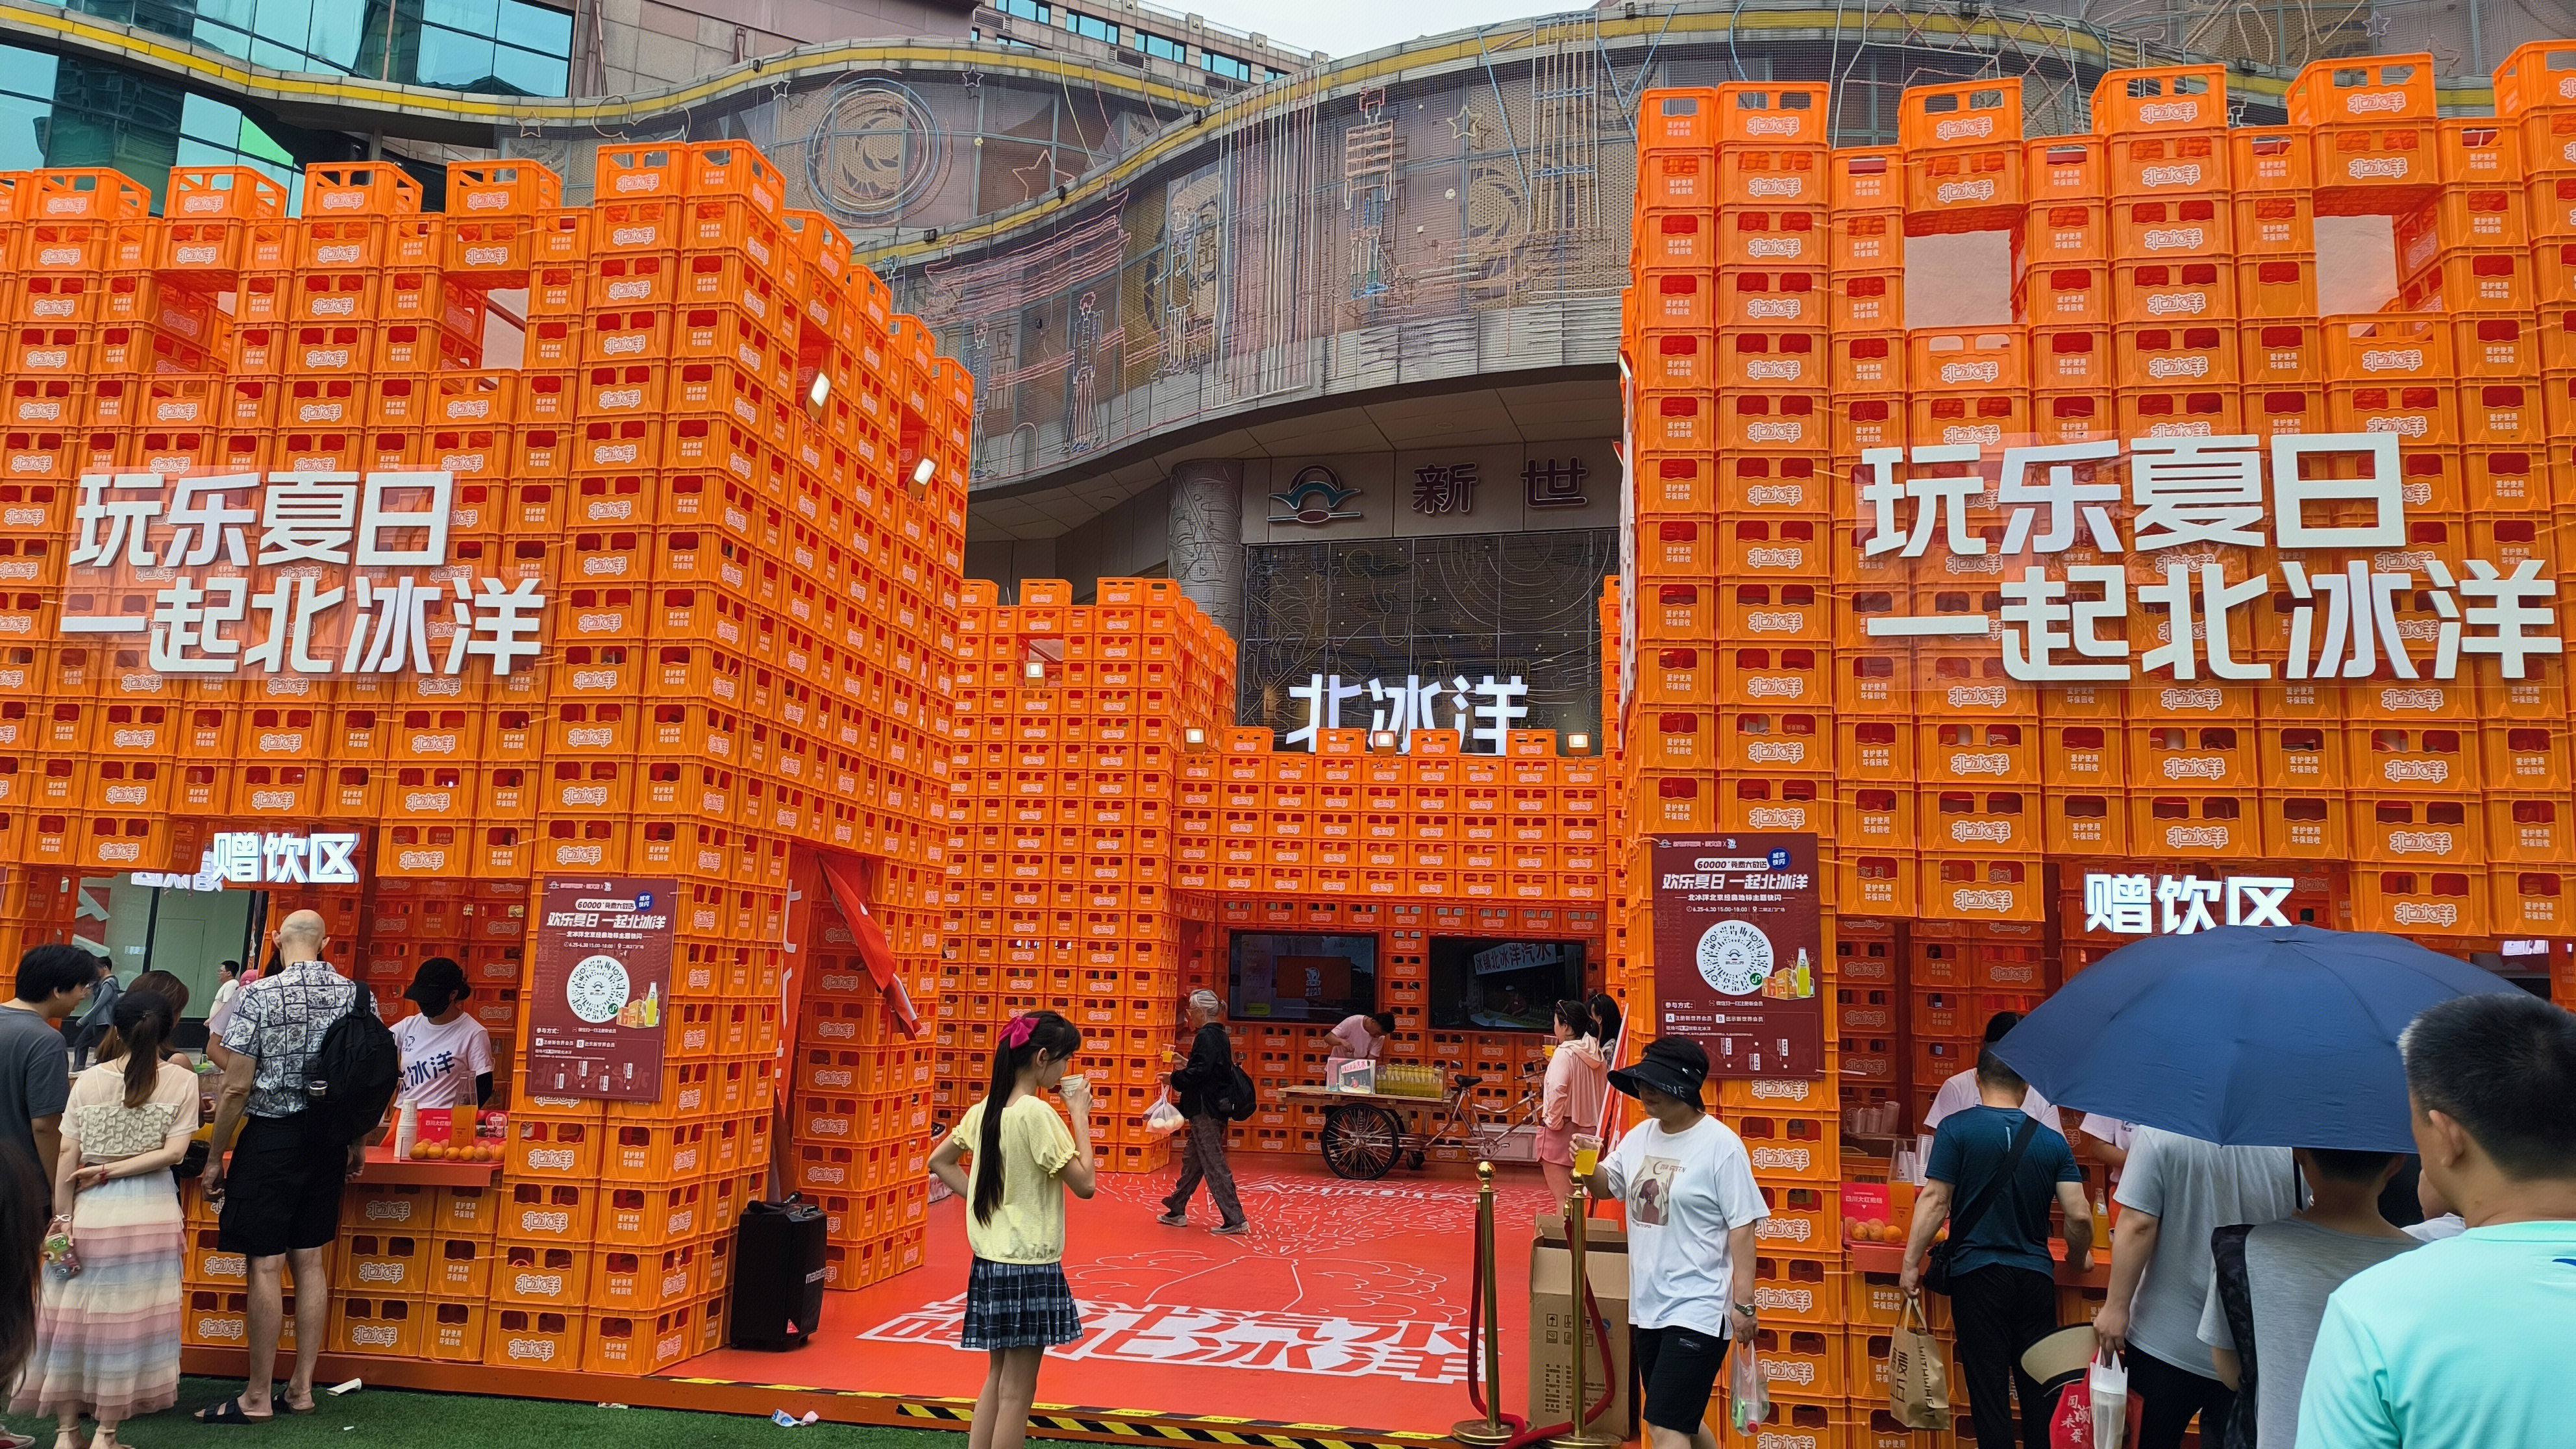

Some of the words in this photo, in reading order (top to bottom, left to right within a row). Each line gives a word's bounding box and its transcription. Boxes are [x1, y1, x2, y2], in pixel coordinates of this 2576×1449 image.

[2347, 92, 2407, 114] 北冰洋
[1746, 117, 1800, 136] 北冰洋
[1937, 117, 1992, 141] 北冰洋
[2142, 164, 2201, 187] 北冰洋
[2348, 157, 2408, 179] 北冰洋
[616, 174, 660, 193] 北冰洋
[1748, 177, 1802, 197] 北冰洋
[1937, 179, 1994, 203] 北冰洋
[47, 197, 88, 214] 北冰洋
[323, 192, 364, 210] 北冰洋
[467, 192, 509, 210] 北冰洋
[613, 227, 655, 245] 北冰洋
[40, 249, 81, 266] 北冰洋
[176, 246, 217, 265] 北冰洋
[465, 247, 508, 266] 北冰洋
[1748, 238, 1801, 258] 北冰洋
[608, 280, 650, 301] 北冰洋
[34, 299, 75, 317] 北冰洋
[312, 297, 354, 316] 北冰洋
[1748, 299, 1801, 319] 北冰洋
[2147, 292, 2206, 315] 北冰洋
[604, 335, 646, 355] 北冰洋
[2485, 347, 2514, 356] 爱护使用
[27, 349, 67, 368] 北冰洋
[2145, 356, 2209, 378] 北冰洋
[2362, 349, 2423, 372] 北冰洋
[1747, 360, 1801, 381] 北冰洋
[599, 390, 641, 409] 北冰洋
[19, 402, 60, 421] 北冰洋
[299, 404, 342, 422] 北冰洋
[11, 455, 53, 473] 北冰洋
[1748, 485, 1802, 506] 北冰洋
[1861, 432, 2407, 557] 玩乐夏日
[68, 470, 453, 567] 玩乐夏日
[588, 501, 631, 520] 北冰洋
[584, 556, 627, 576] 北冰洋
[60, 576, 546, 675] 一起北冰洋
[578, 613, 622, 633] 北冰洋
[1748, 612, 1803, 634] 北冰洋
[1867, 560, 2562, 681] 一起北冰洋
[121, 674, 162, 693] 北冰洋
[418, 678, 462, 697] 北冰洋
[1948, 686, 2007, 708] 北冰洋
[1286, 674, 1529, 756] 北冰洋
[114, 730, 155, 748] 北冰洋
[412, 735, 456, 754] 北冰洋
[568, 728, 613, 748] 北冰洋
[1666, 738, 1692, 747] 爱护使用
[1748, 742, 1804, 763] 北冰洋
[1862, 750, 1889, 758] 爱护使用
[2290, 756, 2318, 766] 爱护使用
[1950, 753, 2010, 776] 北冰洋
[2163, 758, 2225, 780] 北冰洋
[2384, 760, 2448, 784] 北冰洋
[106, 786, 147, 805] 北冰洋
[252, 791, 295, 810] 北冰洋
[405, 793, 450, 812] 北冰洋
[1749, 807, 1805, 829] 北冰洋
[2072, 823, 2101, 832] 爱护使用
[1951, 821, 2011, 843] 北冰洋
[2072, 832, 2101, 840] 环保回收
[2166, 826, 2229, 849] 北冰洋
[2292, 834, 2321, 844] 环保回收
[99, 842, 140, 861] 北冰洋
[2389, 831, 2453, 855] 北冰洋
[212, 832, 360, 884] 赠饮区
[399, 851, 444, 871] 北冰洋
[556, 845, 602, 865] 北冰洋
[1663, 874, 1726, 890] 欢乐夏日
[1729, 874, 1809, 890] 一起北冰洋
[1953, 889, 2013, 913] 北冰洋
[2084, 873, 2294, 935] 赠饮区
[2524, 902, 2553, 911] 爱护使用
[547, 912, 600, 928] 欢乐夏日
[601, 914, 667, 930] 一起北冰洋
[2394, 902, 2457, 927] 北冰洋
[2525, 911, 2553, 920] 环保回收
[1752, 1080, 1809, 1101] 北冰洋
[528, 1148, 575, 1170] 北冰洋
[1753, 1146, 1810, 1172] 北冰洋
[522, 1211, 568, 1233] 北冰洋
[359, 1263, 404, 1283] 北冰洋
[515, 1274, 562, 1296] 北冰洋
[1755, 1287, 1813, 1313] 北冰洋
[353, 1326, 397, 1347] 北冰洋
[508, 1339, 554, 1361] 北冰洋
[1759, 1359, 1814, 1385] 北冰洋
